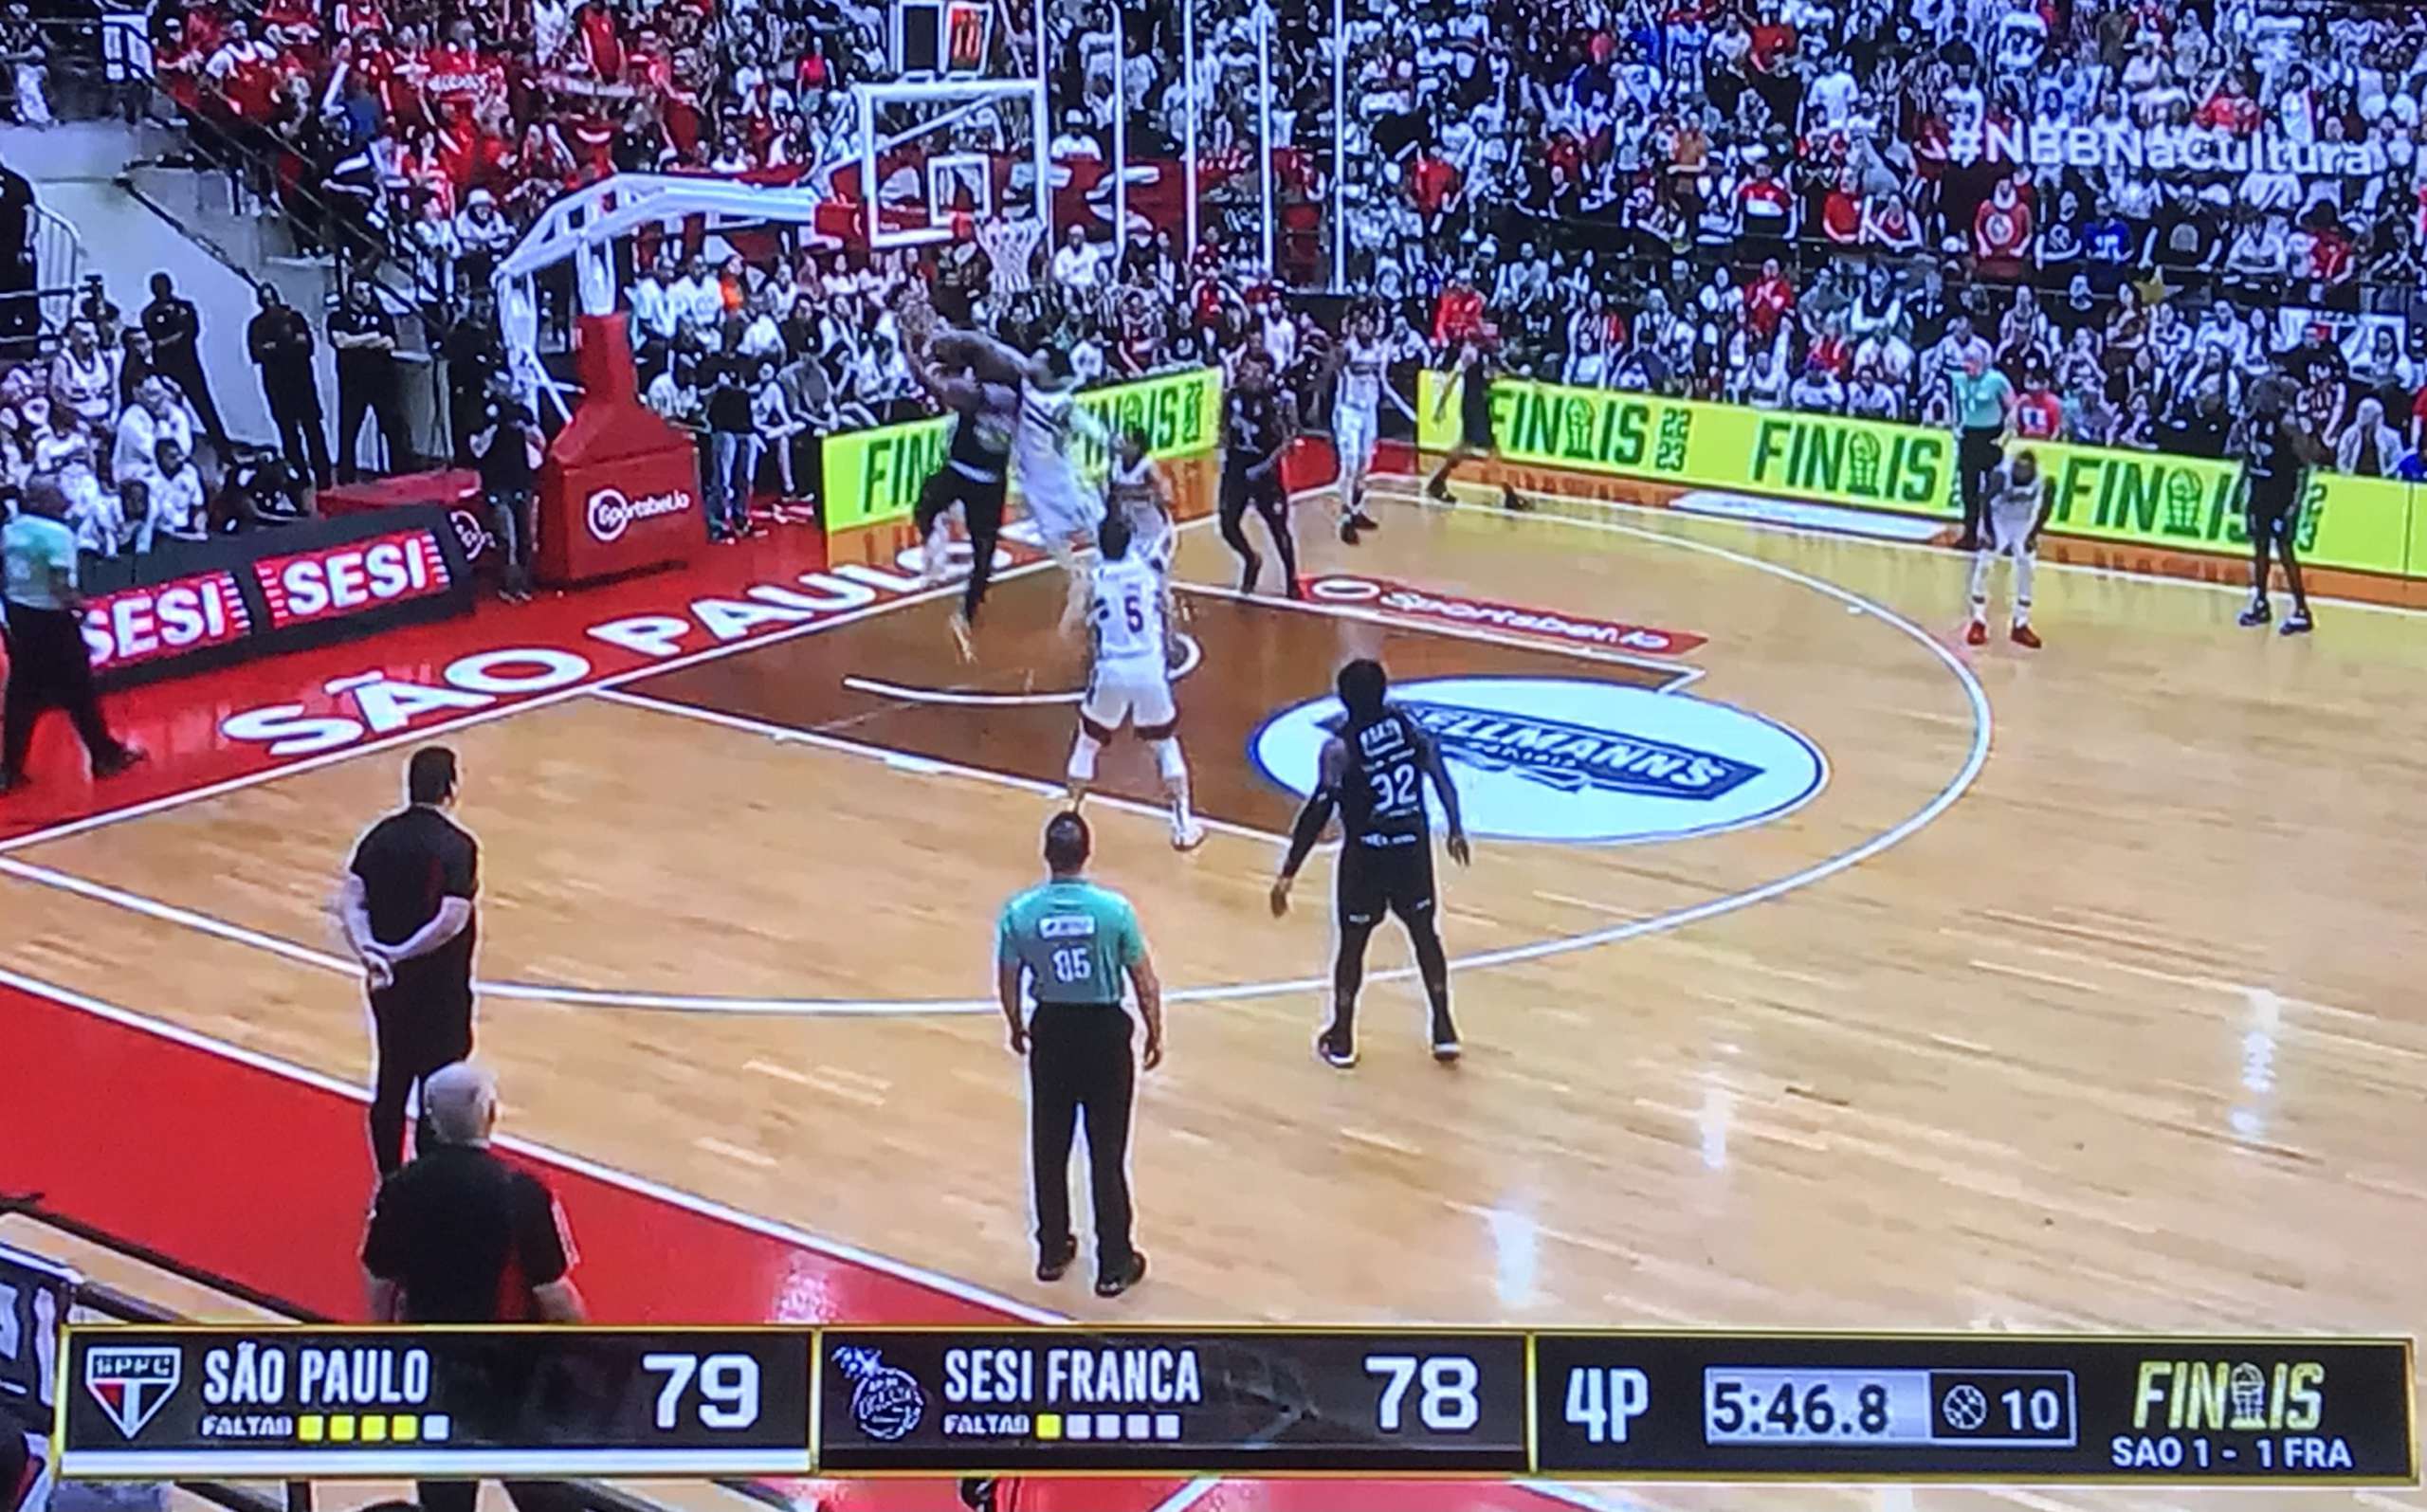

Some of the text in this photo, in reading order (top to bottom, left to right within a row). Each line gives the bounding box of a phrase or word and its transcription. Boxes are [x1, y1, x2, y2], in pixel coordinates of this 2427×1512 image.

[1948, 124, 2370, 175] #NBBNaCultura
[283, 537, 427, 617] SESI
[81, 580, 226, 668] SESI
[221, 647, 592, 756] SÃO
[203, 1341, 429, 1405] SÃO PAULO
[643, 1354, 761, 1430] 79
[944, 1349, 1033, 1403] SESI
[1047, 1349, 1202, 1403] FRANCA
[1366, 1356, 1480, 1431] 78
[1564, 1366, 1651, 1442] 4P
[1712, 1381, 1889, 1434] 5:46.8
[2001, 1388, 2061, 1432] 10
[2110, 1435, 2183, 1467] SAO
[2193, 1437, 2210, 1468] 1
[2256, 1437, 2272, 1468] 1
[2283, 1437, 2353, 1468] FRA
